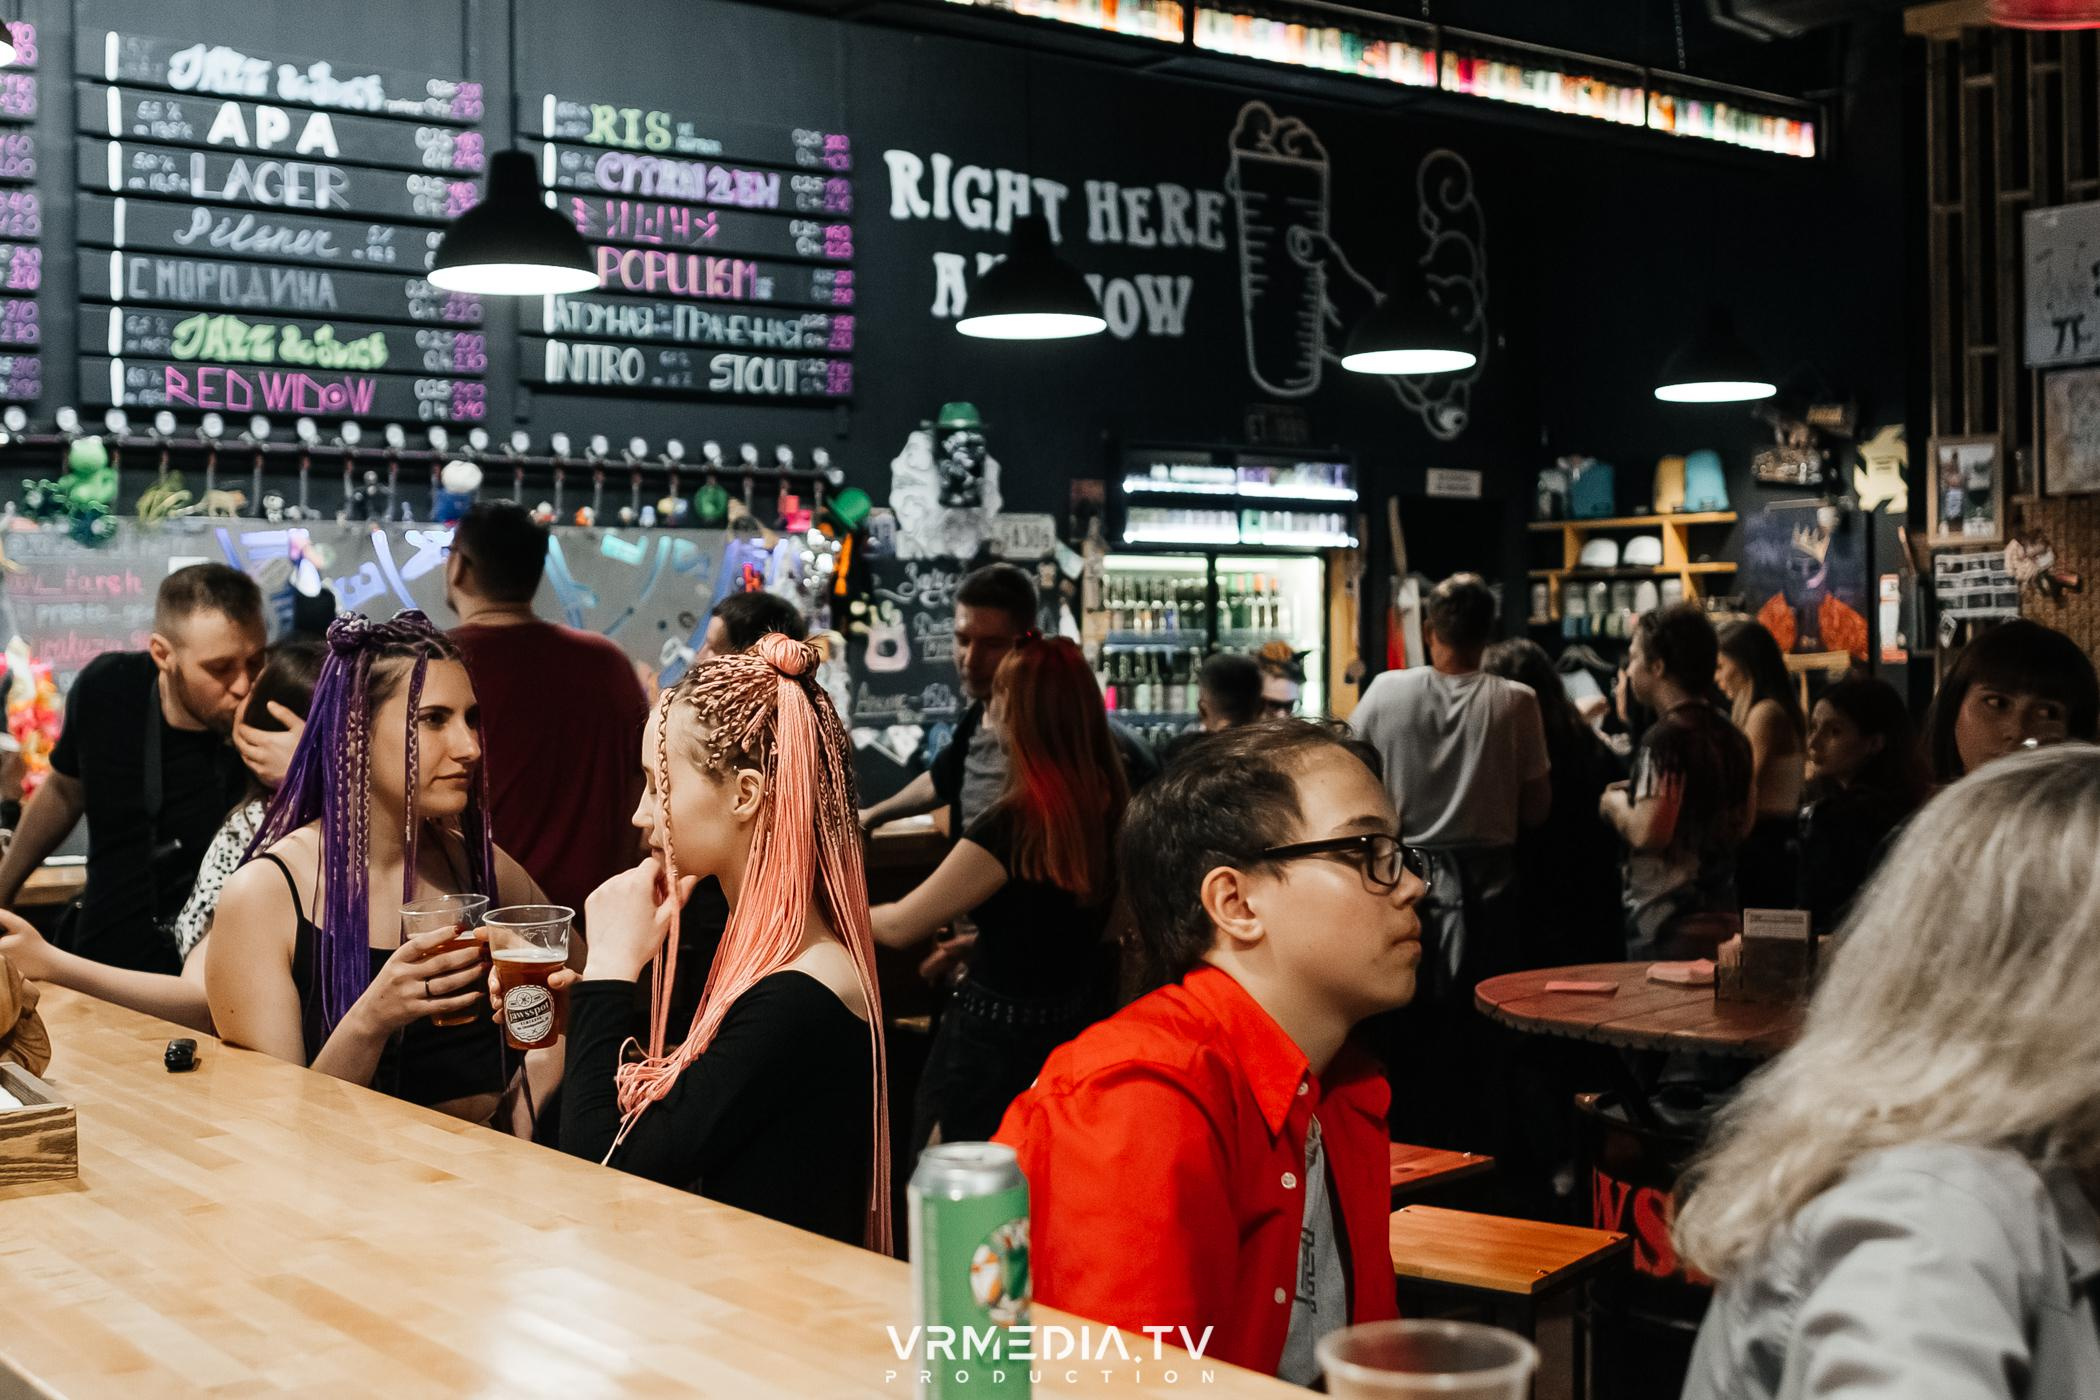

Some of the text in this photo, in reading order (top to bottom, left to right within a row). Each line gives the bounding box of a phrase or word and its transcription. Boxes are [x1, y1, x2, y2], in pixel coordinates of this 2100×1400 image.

[206, 101, 340, 158] APA
[585, 104, 673, 151] RIS
[189, 152, 352, 210] LAGER
[883, 150, 1068, 245] RIGHT
[1084, 179, 1227, 251] HERE
[597, 247, 758, 300] POPULISM
[164, 364, 253, 412] RED
[258, 370, 377, 415] WIDOW
[709, 353, 798, 396] STOUT
